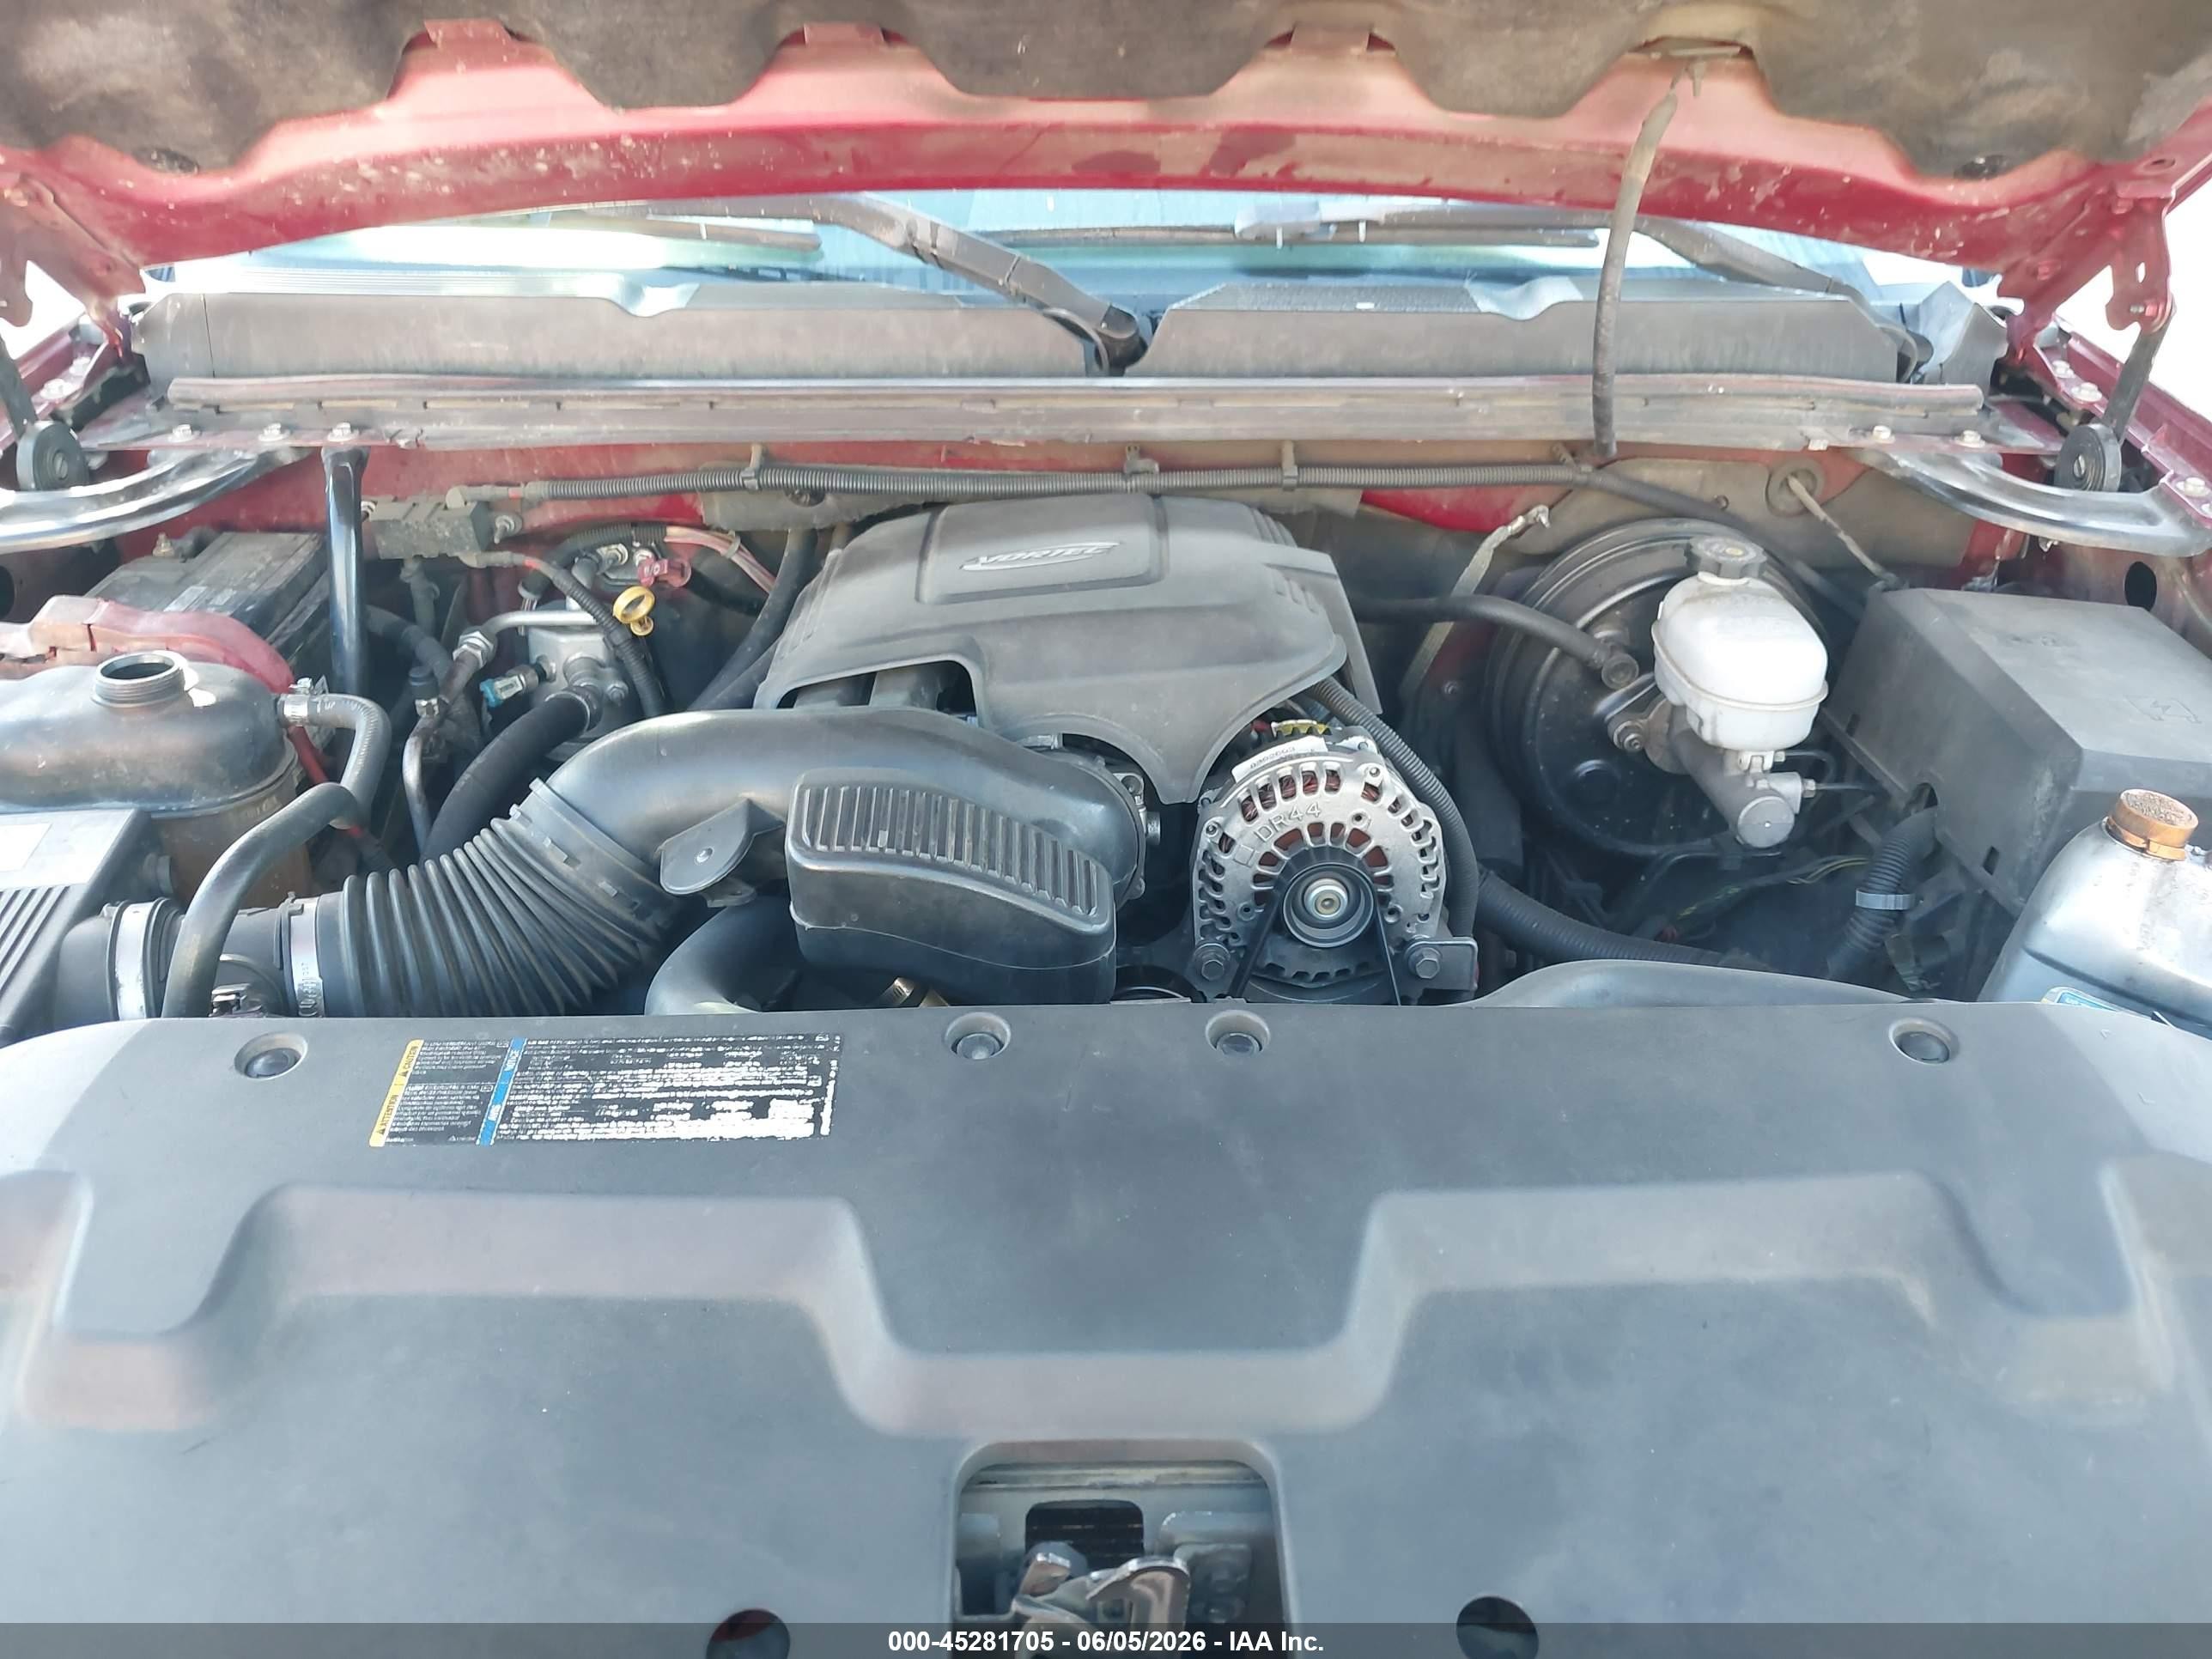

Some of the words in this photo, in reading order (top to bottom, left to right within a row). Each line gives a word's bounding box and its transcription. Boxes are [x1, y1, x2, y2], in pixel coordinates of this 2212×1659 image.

[1254, 802, 1321, 842] DR44
[404, 1046, 419, 1070] CAUTION
[381, 1094, 399, 1129] ATTENTION
